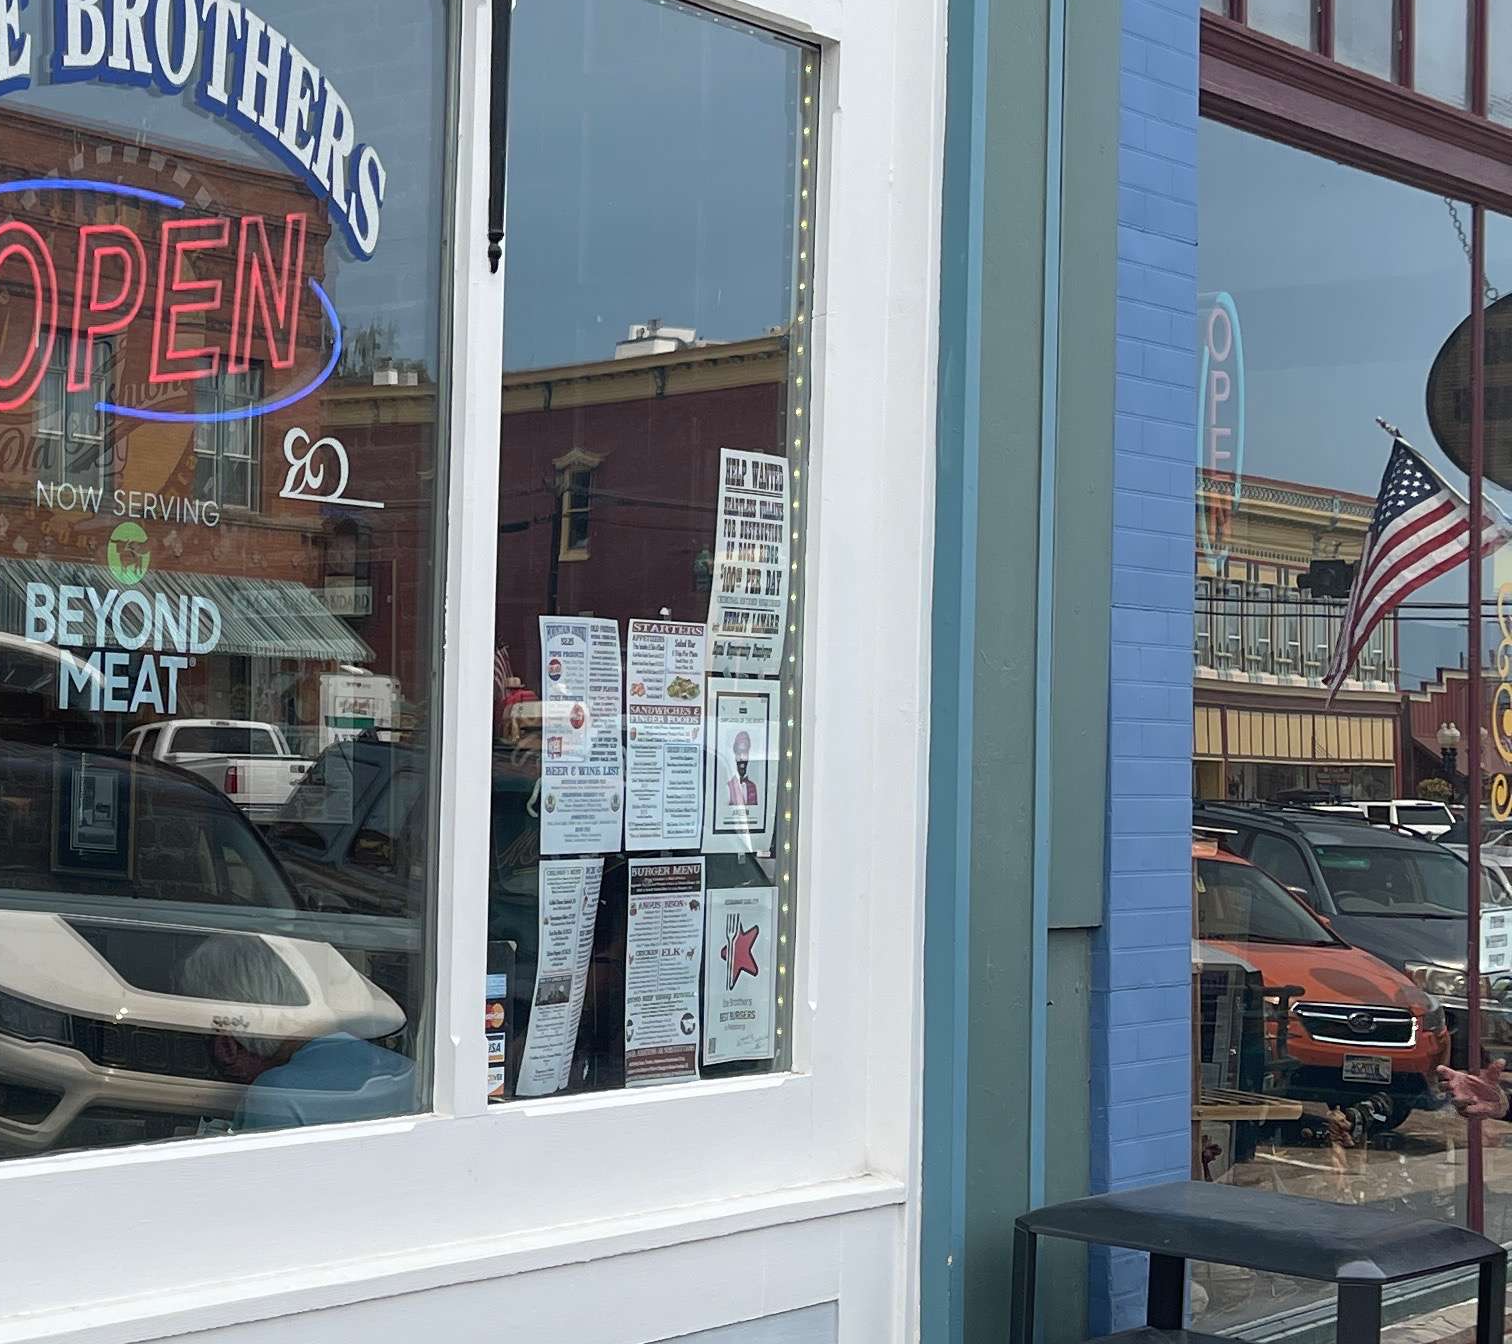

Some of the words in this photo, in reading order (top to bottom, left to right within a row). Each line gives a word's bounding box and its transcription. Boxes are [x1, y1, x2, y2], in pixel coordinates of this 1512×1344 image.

[1208, 306, 1233, 543] OPEN
[35, 480, 103, 514] NOW
[112, 489, 220, 527] SERVING
[745, 568, 762, 595] PER
[765, 570, 783, 596] DAY
[25, 582, 221, 655] BEYOND
[633, 623, 704, 636] STARTERS
[58, 650, 190, 716] MEAT
[630, 706, 691, 716] SANDWICHES
[667, 715, 699, 725] FOODS
[545, 766, 569, 776] BEER
[579, 766, 601, 776] WINE
[603, 766, 620, 776] LIST
[631, 866, 671, 876] BURGER
[673, 864, 701, 875] MENU
[662, 948, 681, 956] ELK
[488, 1042, 501, 1053] ISA
